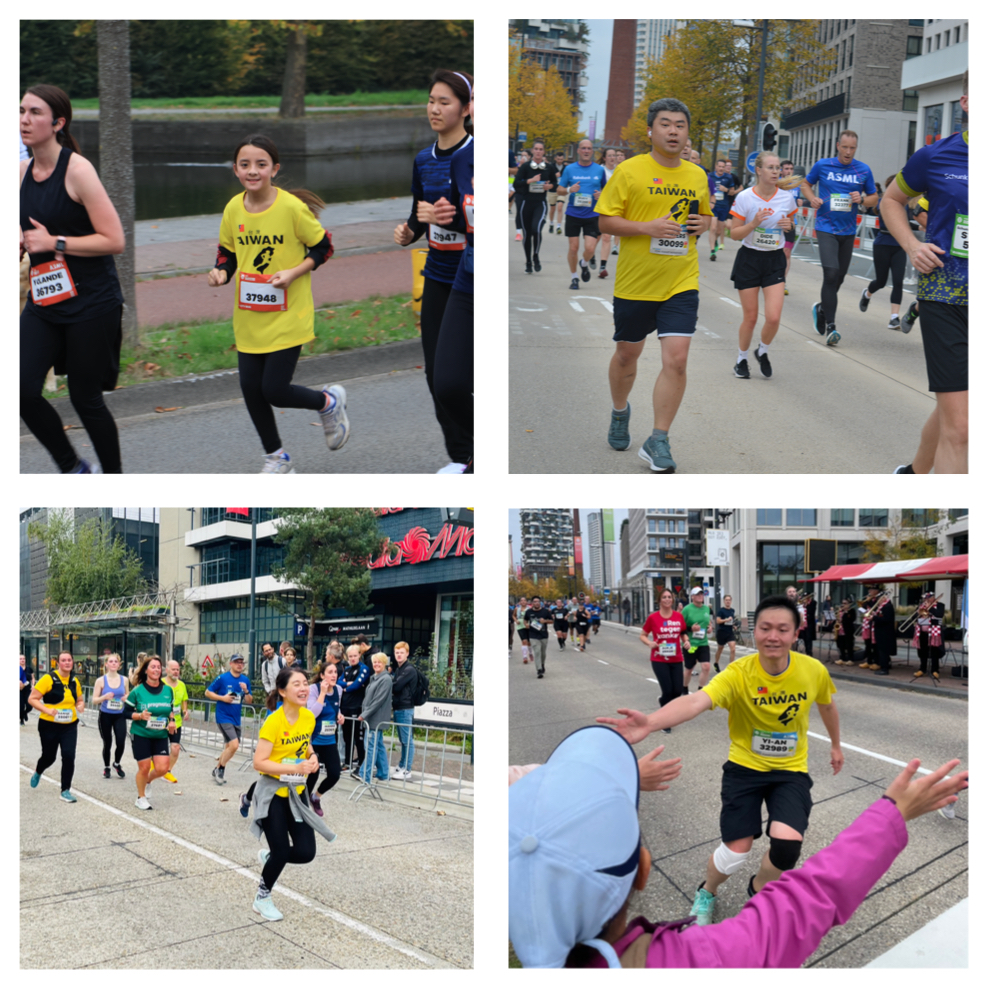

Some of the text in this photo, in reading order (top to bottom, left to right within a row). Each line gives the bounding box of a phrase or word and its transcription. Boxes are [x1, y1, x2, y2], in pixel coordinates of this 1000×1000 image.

[827, 171, 860, 184] ASML
[647, 186, 697, 198] TAIWAN
[658, 239, 685, 248] 30099
[246, 293, 277, 303] 37948
[752, 692, 807, 706] TAIWAN
[433, 706, 454, 717] Piazza
[759, 744, 788, 752] 32989
